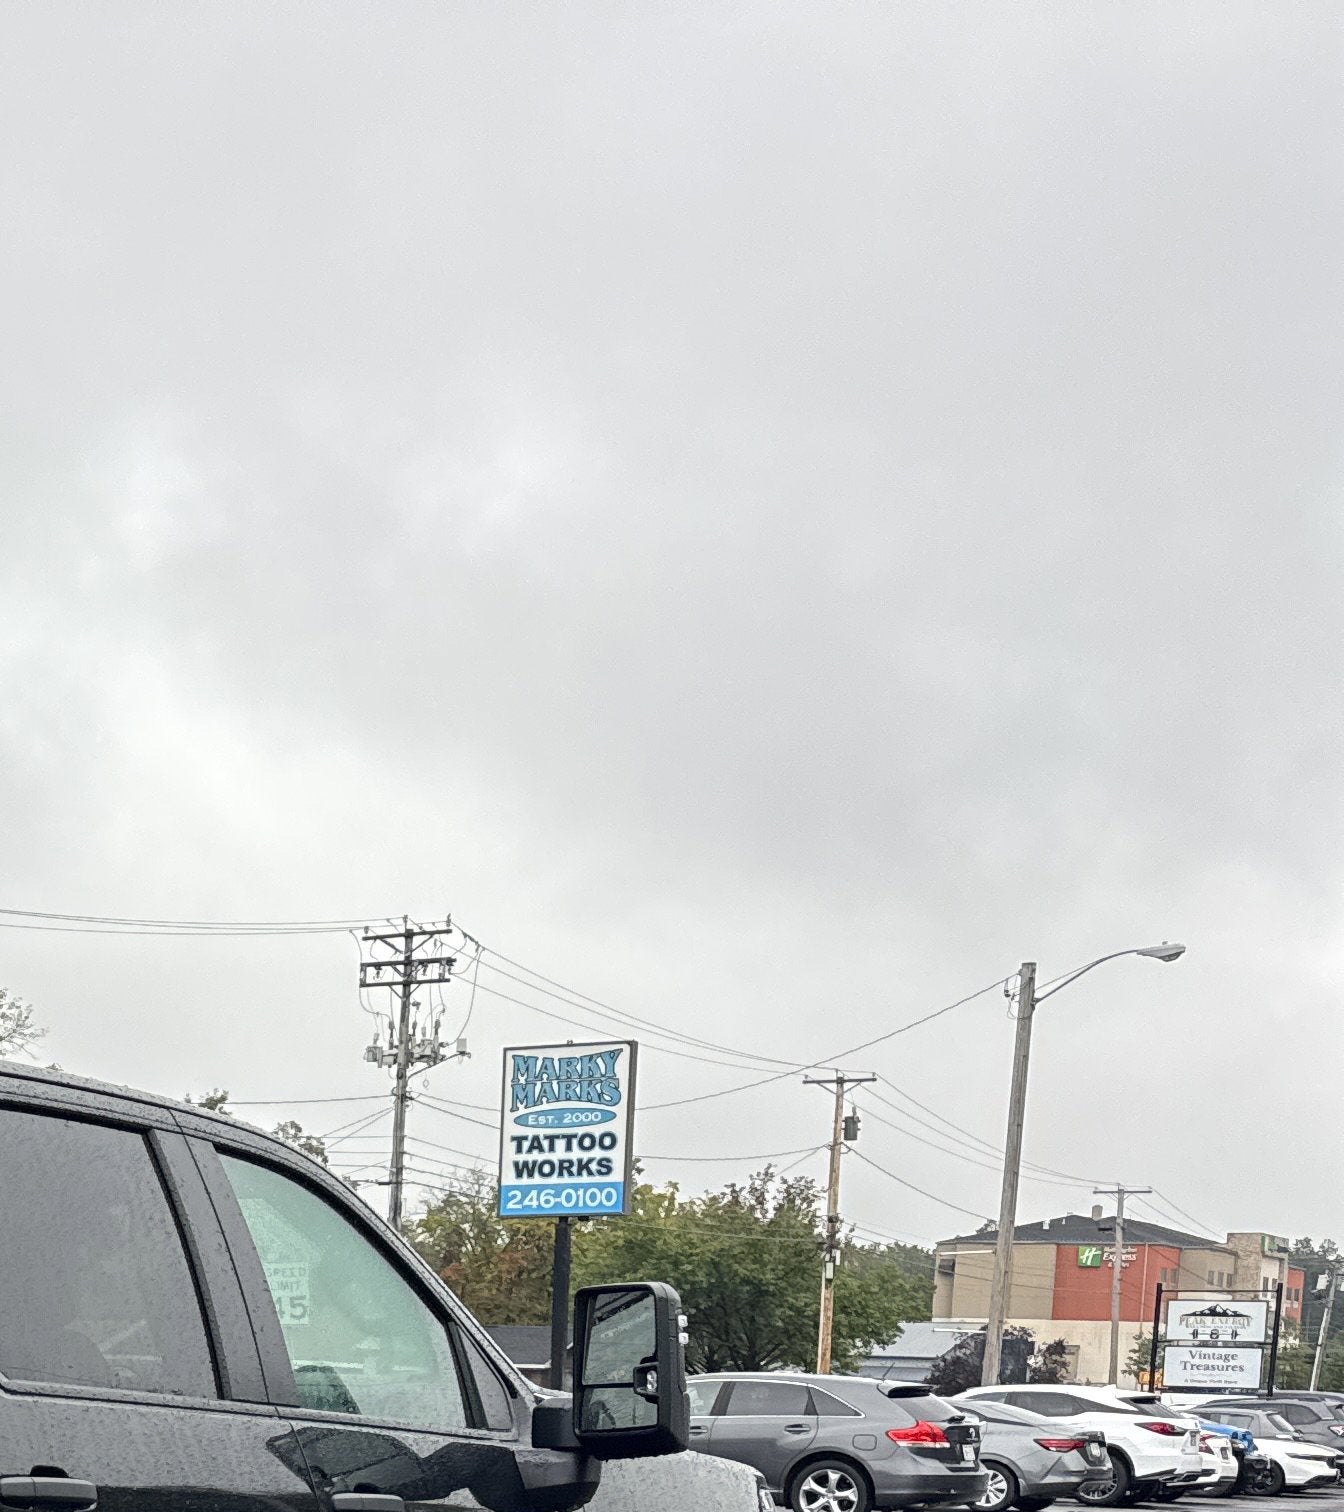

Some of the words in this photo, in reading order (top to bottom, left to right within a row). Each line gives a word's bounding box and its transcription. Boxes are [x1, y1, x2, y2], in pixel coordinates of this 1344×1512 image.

[511, 1048, 623, 1081] MARKY
[510, 1077, 622, 1112] MARKS
[563, 1111, 602, 1122] 2000
[510, 1131, 617, 1155] TATTOO
[513, 1157, 613, 1179] WORKS
[506, 1187, 618, 1209] 246-0100
[1180, 1360, 1245, 1372] Treasures
[1188, 1350, 1239, 1363] Vintage
